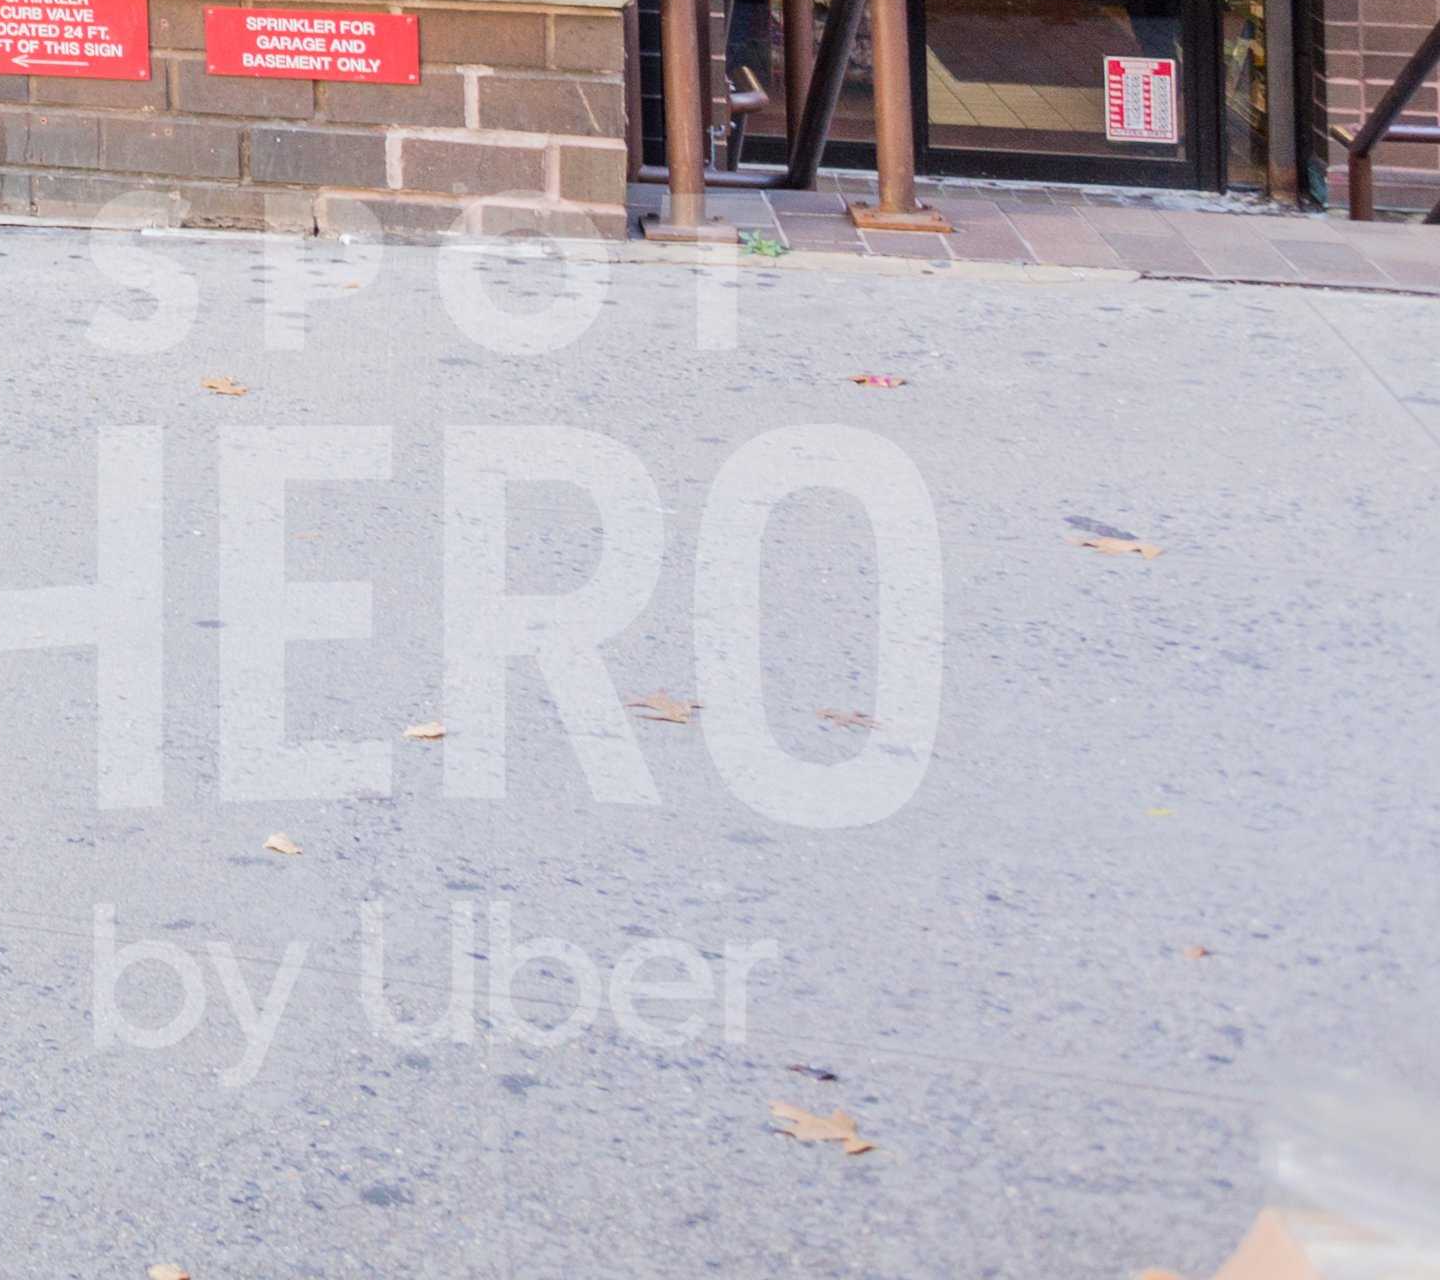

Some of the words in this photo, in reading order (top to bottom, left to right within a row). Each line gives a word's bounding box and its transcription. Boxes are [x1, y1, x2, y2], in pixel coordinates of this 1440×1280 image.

[0, 6, 43, 21] CURB
[46, 7, 95, 23] VALVE
[63, 24, 84, 40] 24
[87, 25, 110, 40] FT.
[245, 16, 336, 34] SPRINKLER
[339, 19, 376, 37] FOR
[17, 39, 39, 54] OF
[43, 41, 80, 56] THIS
[84, 42, 124, 58] SIGN
[256, 35, 326, 52] GARAGE
[330, 38, 367, 54] AND
[242, 53, 332, 70] BASEMENT
[336, 57, 382, 74] ONLY
